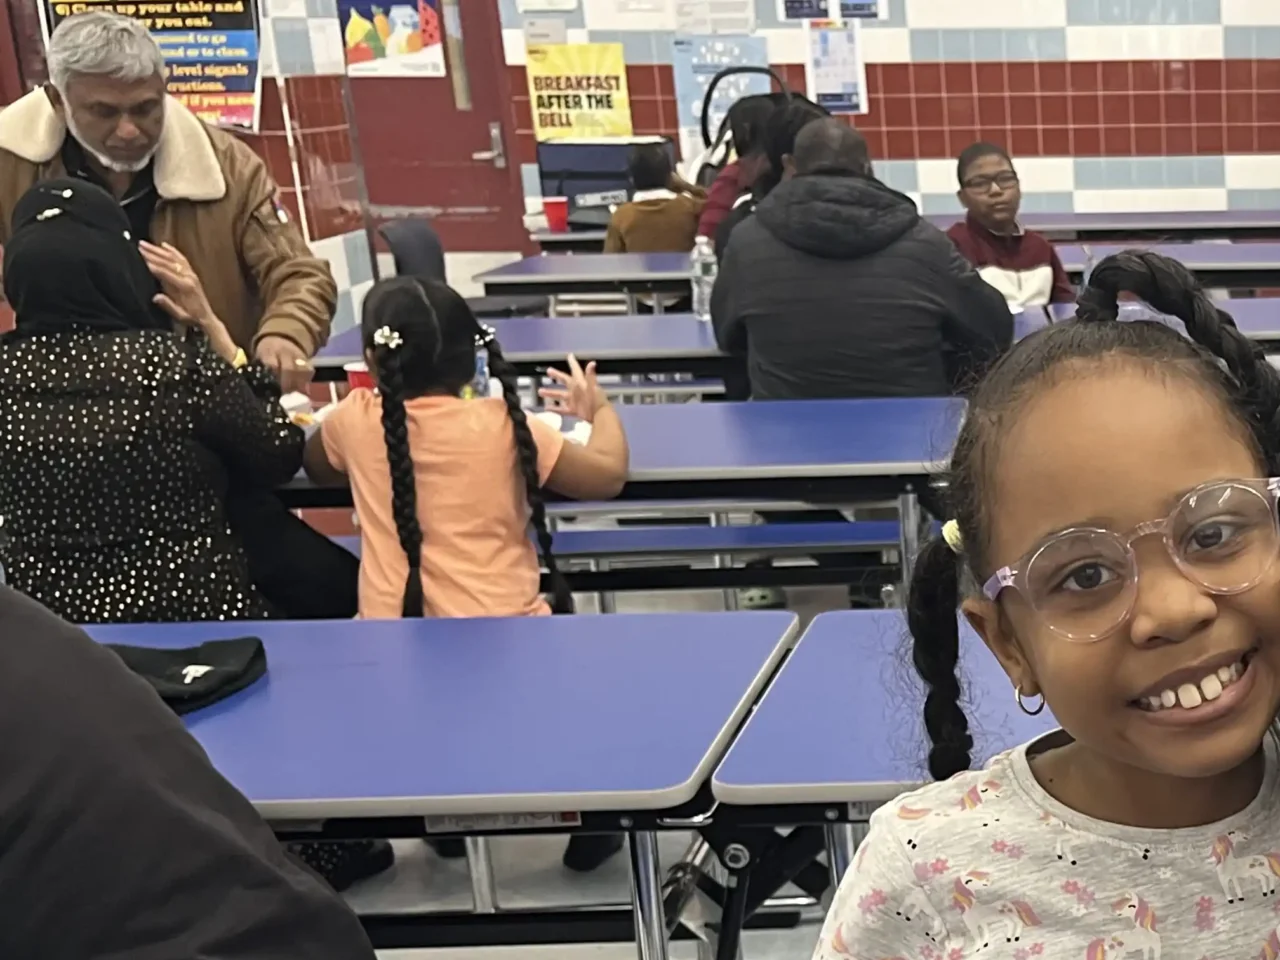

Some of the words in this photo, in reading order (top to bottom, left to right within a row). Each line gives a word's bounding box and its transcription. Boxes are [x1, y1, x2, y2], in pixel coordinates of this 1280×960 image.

[116, 4, 136, 15] up
[138, 4, 173, 15] your
[175, 2, 213, 13] table
[215, 1, 244, 13] and
[155, 19, 183, 29] you
[173, 64, 202, 76] level
[204, 63, 249, 78] signals
[533, 75, 620, 92] BREAKFAST
[536, 94, 583, 110] AFTER
[585, 94, 614, 109] THE
[538, 112, 573, 128] BELL
